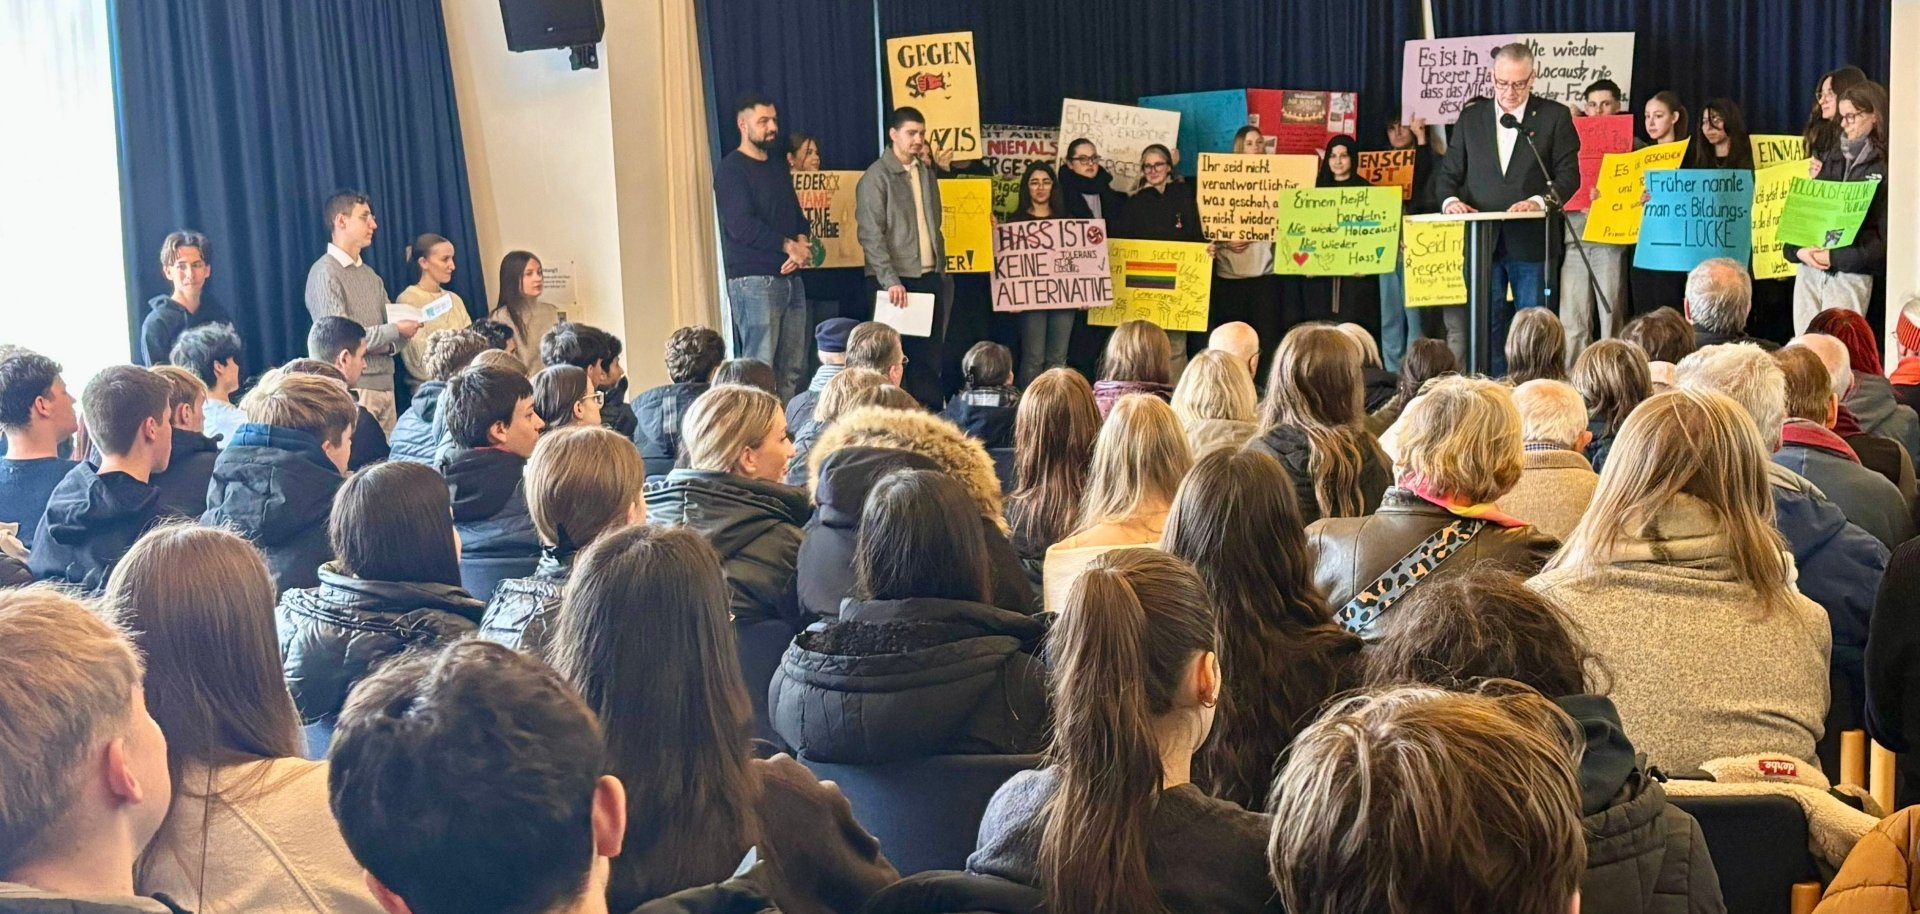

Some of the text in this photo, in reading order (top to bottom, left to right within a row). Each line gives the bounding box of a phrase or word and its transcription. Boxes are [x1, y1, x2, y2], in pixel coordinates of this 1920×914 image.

[897, 41, 972, 68] GEGEN
[1418, 46, 1479, 67] Es ist in
[1420, 67, 1492, 85] Unserer Ha
[929, 127, 976, 152] AZIS
[987, 141, 1058, 156] NIEMALS
[1202, 154, 1271, 173] Ihr seid nicht
[1360, 150, 1415, 168] ENSCH
[794, 173, 826, 190] EDER
[1365, 166, 1400, 182] IST
[1650, 171, 1697, 193] Früher
[1702, 172, 1745, 193] nannte
[1202, 178, 1283, 191] verantwortlich
[1202, 195, 1225, 206] was
[1212, 211, 1235, 225] nicht
[1644, 203, 1671, 217] man
[1675, 203, 1688, 217] es
[998, 220, 1089, 251] HASS IST
[1204, 225, 1275, 240] dafür schon!
[1344, 223, 1398, 236] Holocaust
[1411, 232, 1446, 257] Seid
[946, 250, 974, 270] ER!
[1348, 247, 1386, 265] Hass!
[994, 252, 1049, 279] KEINE
[996, 276, 1114, 306] ALTERNATIVE
[1763, 761, 1795, 775] derbe
